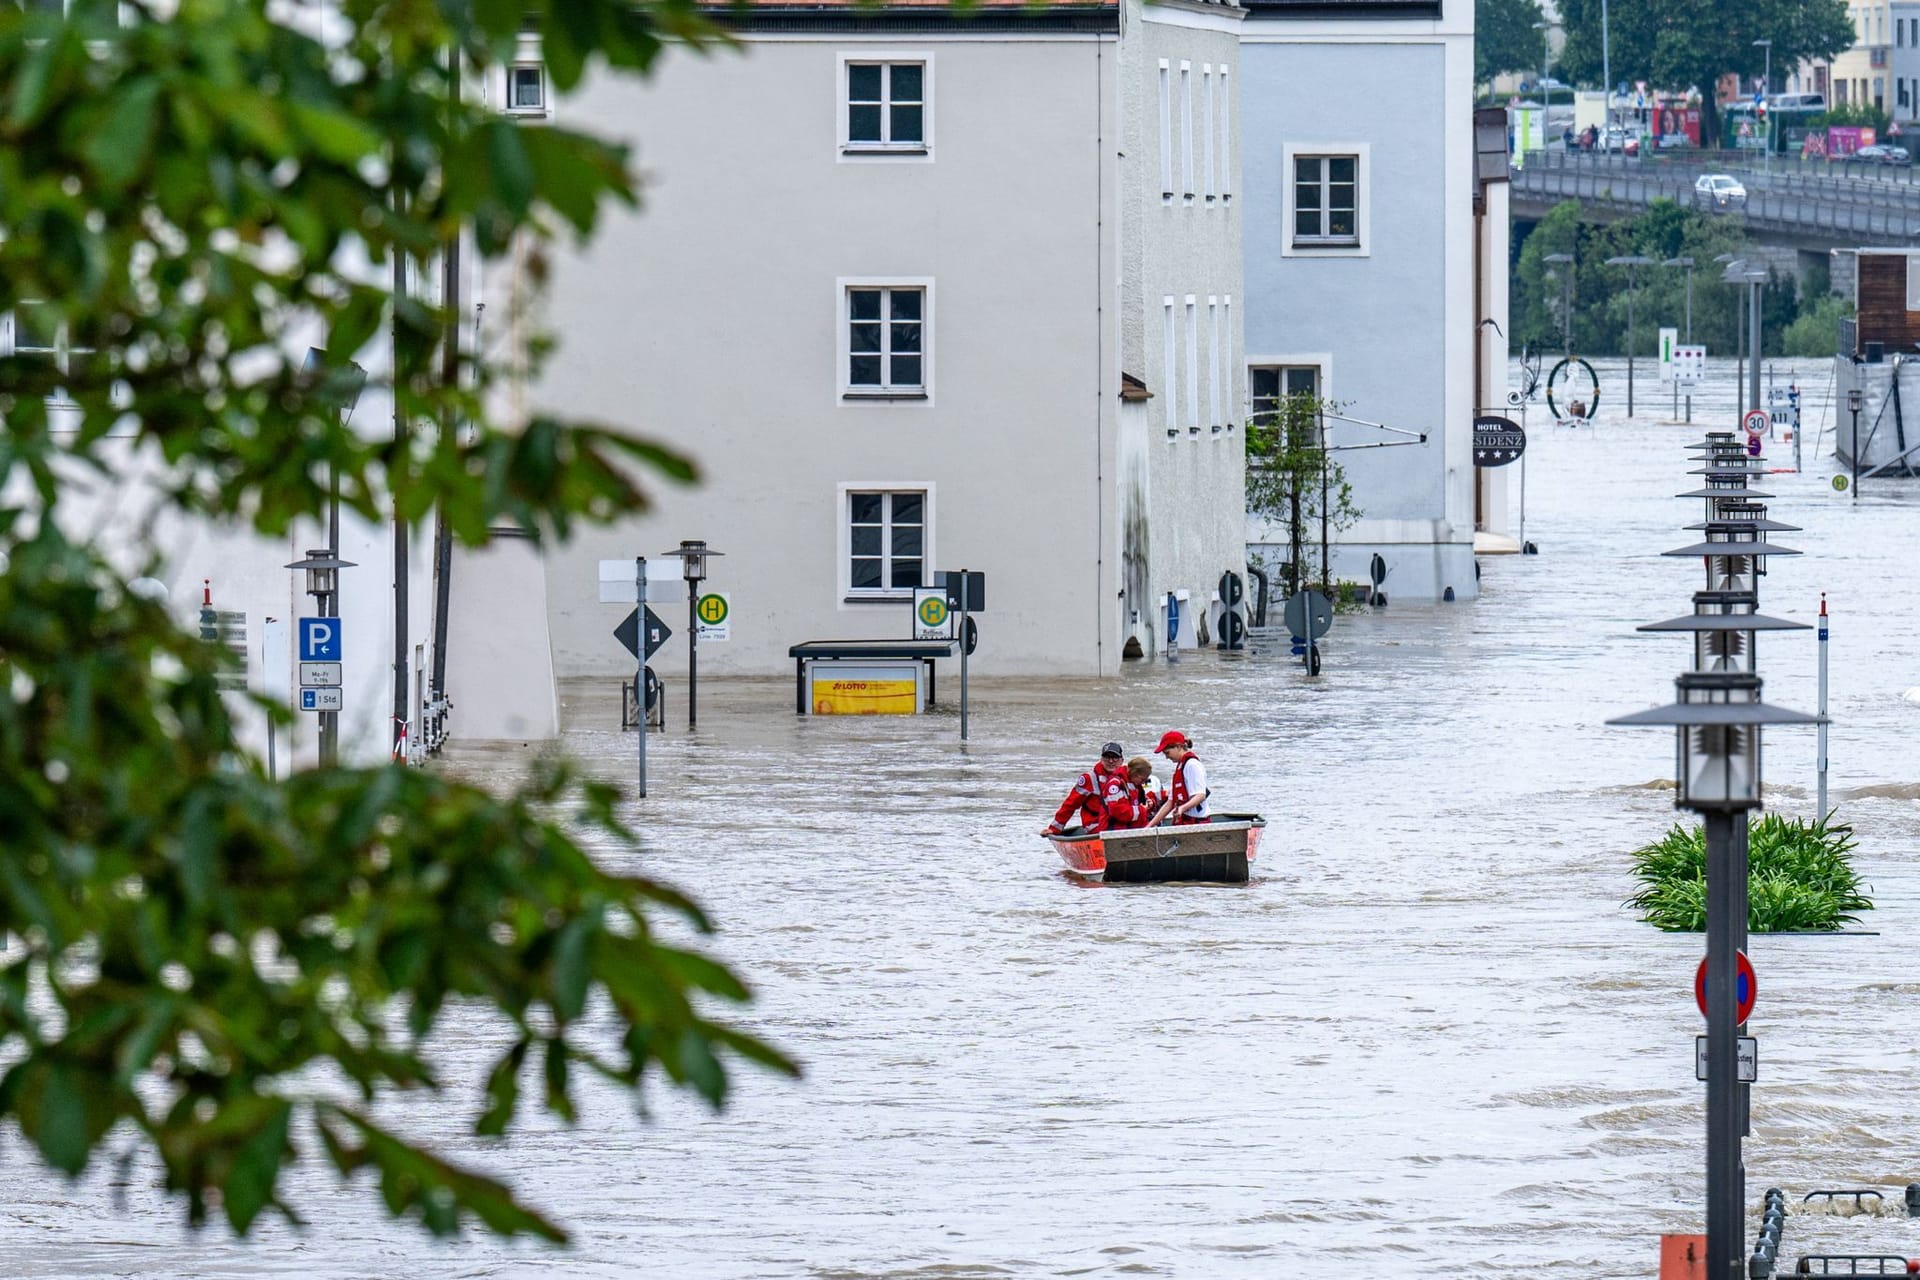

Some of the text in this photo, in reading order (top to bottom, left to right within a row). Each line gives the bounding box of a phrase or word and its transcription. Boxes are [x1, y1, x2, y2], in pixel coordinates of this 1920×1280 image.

[1749, 417, 1764, 429] 30
[1771, 413, 1788, 423] A11
[1473, 436, 1522, 446] SIDENZ
[707, 601, 719, 618] H
[926, 604, 940, 619] H
[309, 623, 331, 656] P
